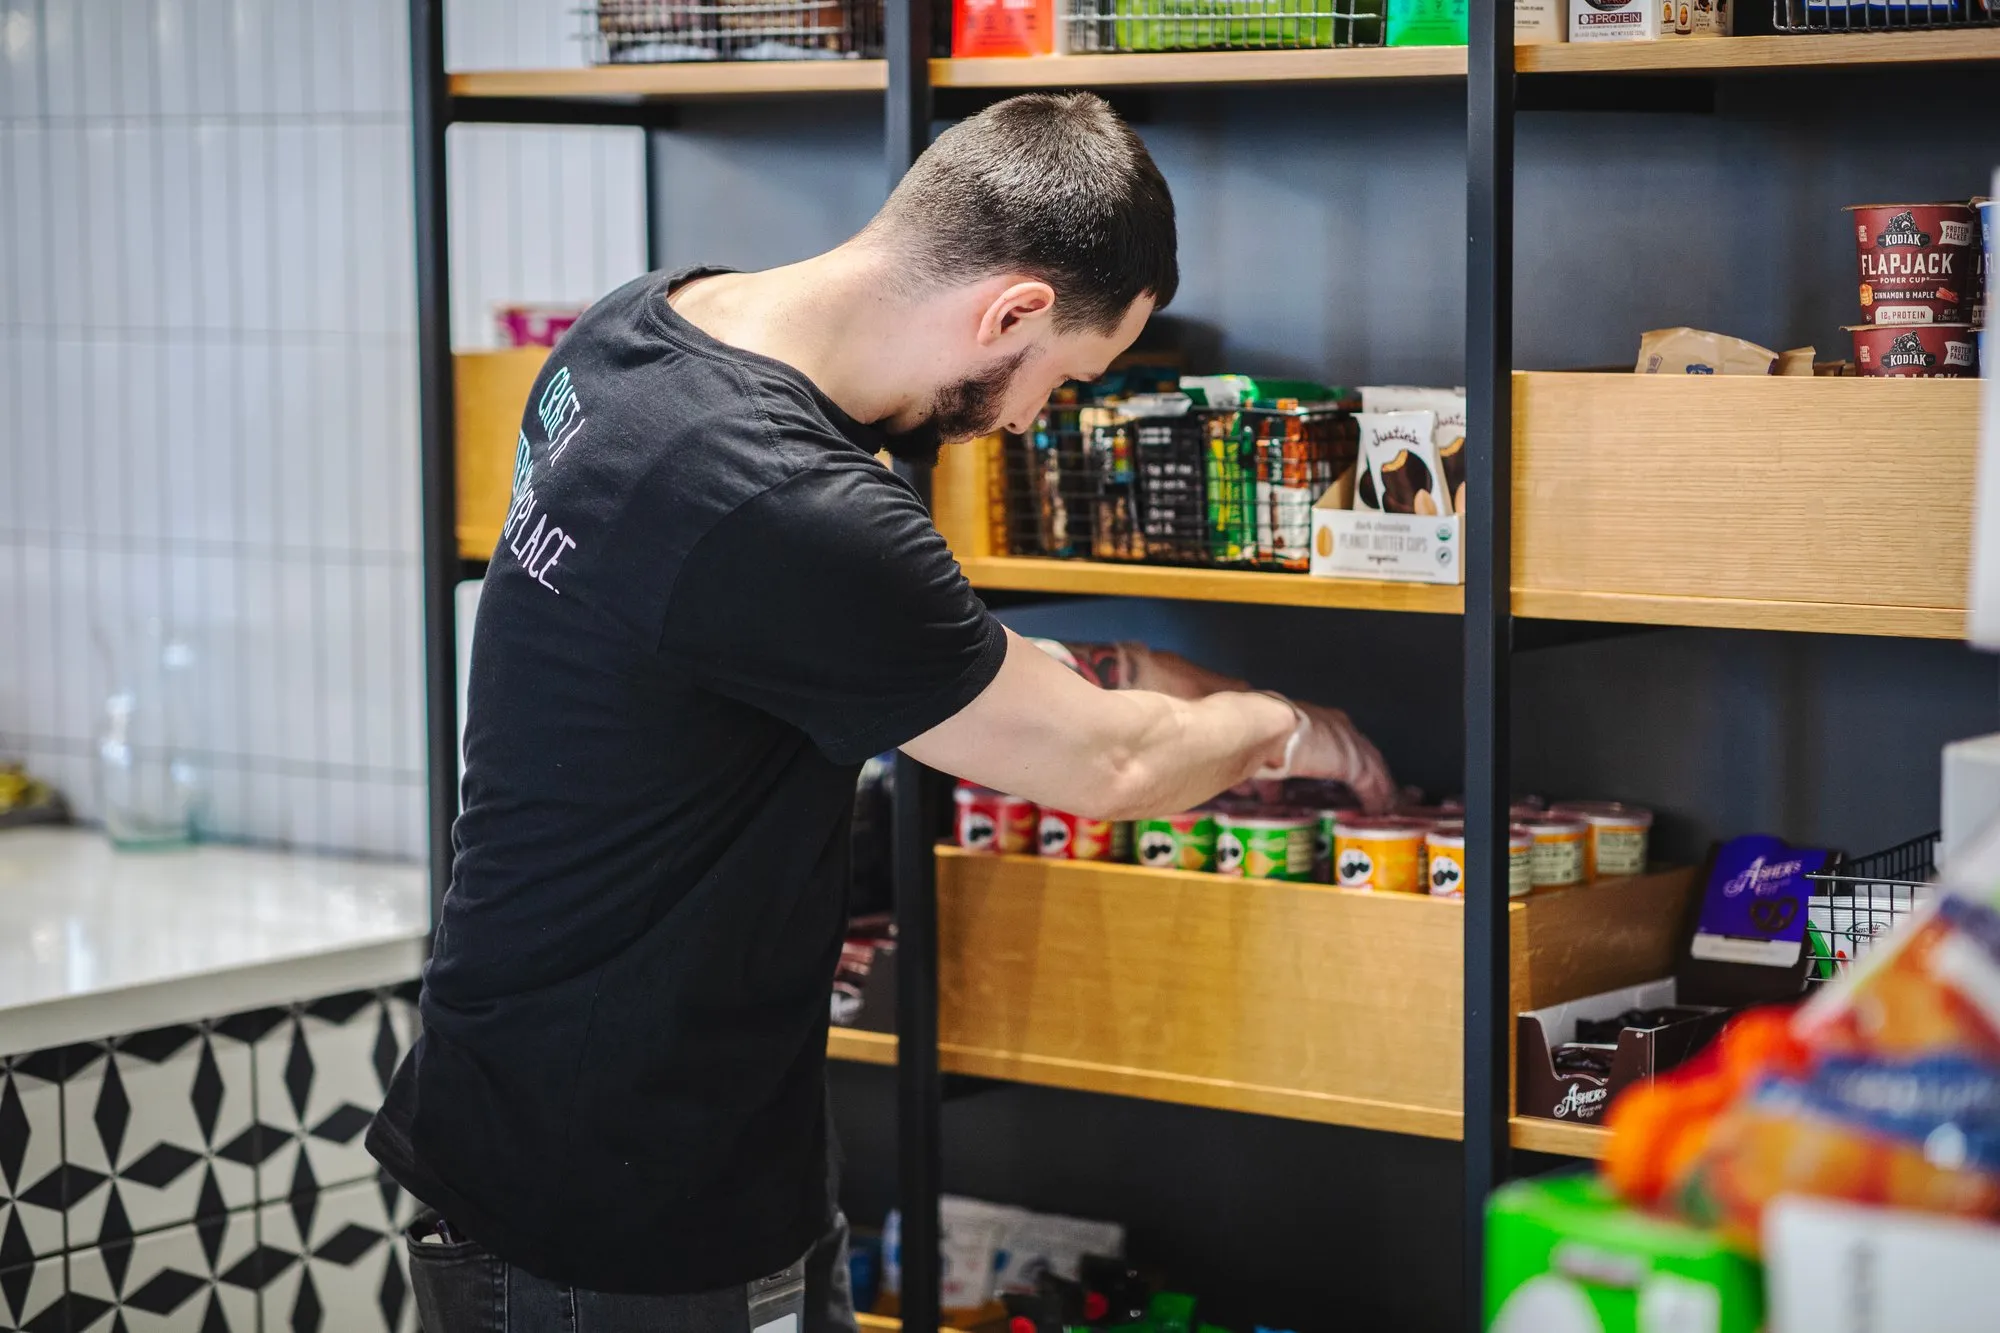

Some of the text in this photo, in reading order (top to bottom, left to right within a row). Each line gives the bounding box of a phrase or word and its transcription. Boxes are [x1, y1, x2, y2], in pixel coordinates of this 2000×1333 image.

[1595, 13, 1641, 24] PROTEIN
[1945, 225, 1969, 234] PROTEIN
[1885, 233, 1921, 247] KODIAK
[1861, 253, 1954, 276] FLAPJACK
[1880, 277, 1906, 285] POWER
[1874, 290, 1935, 300] CINNAMON & MAPLE
[1892, 310, 1927, 320] PROTEIN
[1890, 354, 1927, 367] KODIAK
[538, 366, 581, 452] CRAFT
[1340, 533, 1428, 553] PEANUT BUTTER CUPS
